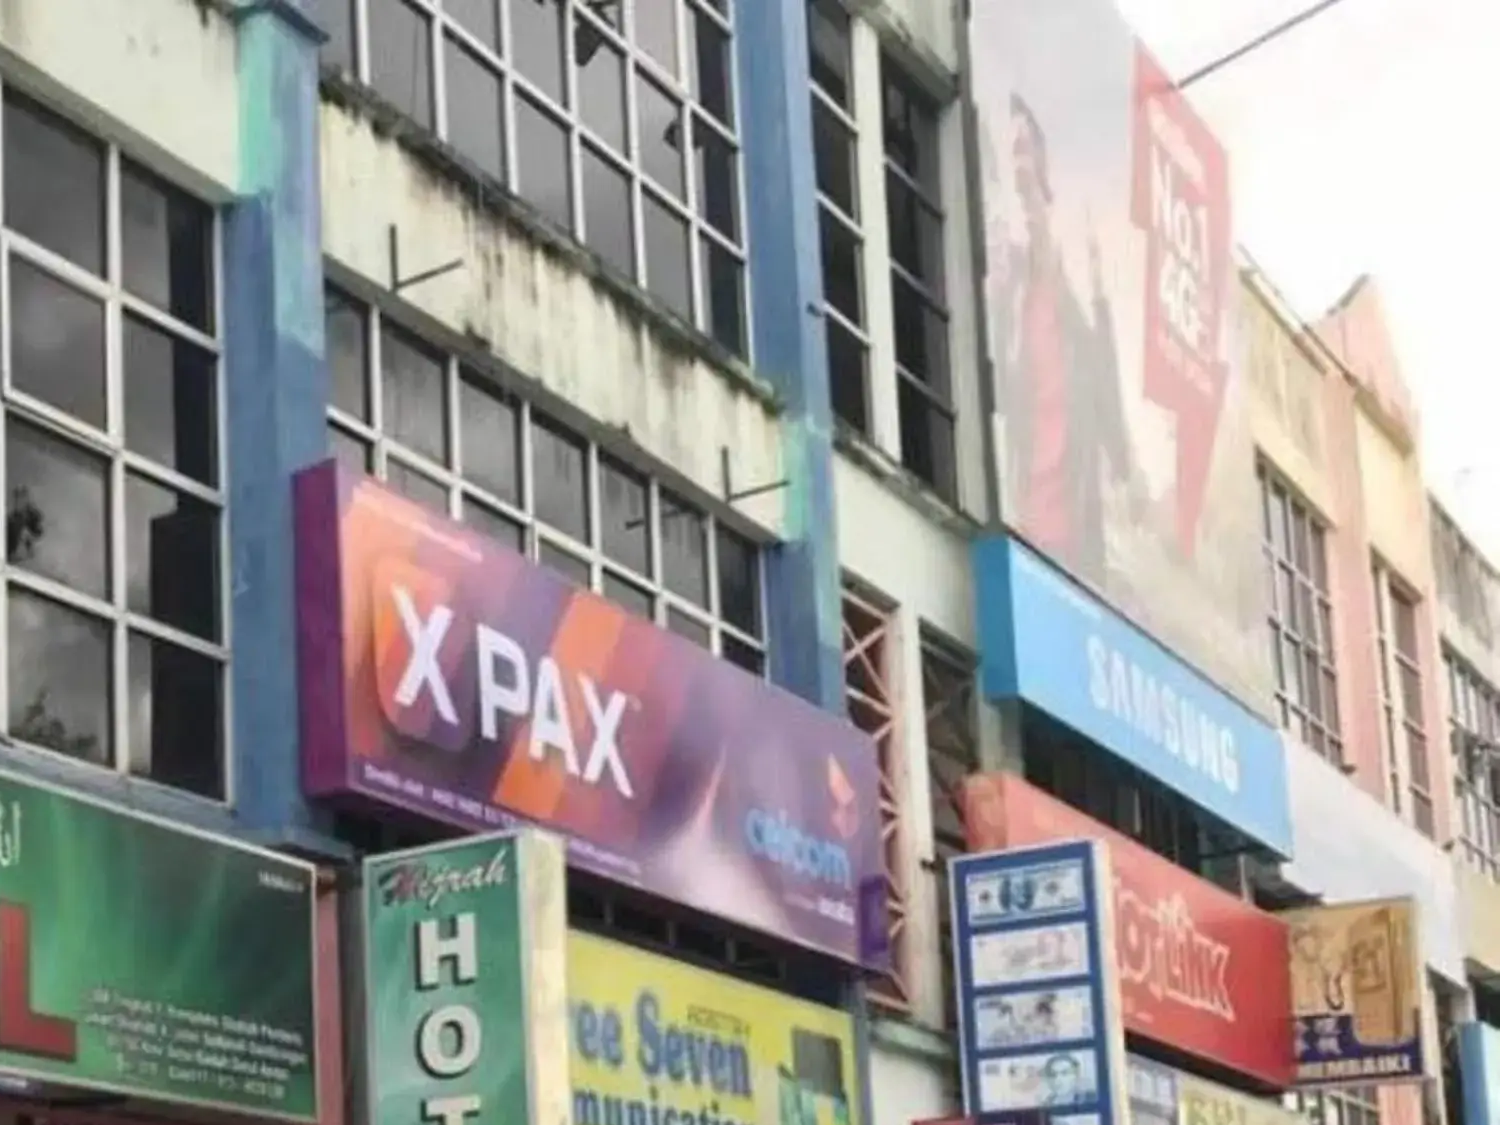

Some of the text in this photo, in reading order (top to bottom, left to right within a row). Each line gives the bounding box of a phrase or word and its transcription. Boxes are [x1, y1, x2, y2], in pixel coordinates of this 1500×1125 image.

[1086, 634, 1239, 795] SAMSUNG
[380, 847, 508, 909] Hijrah
[570, 988, 752, 1099] ee Seven
